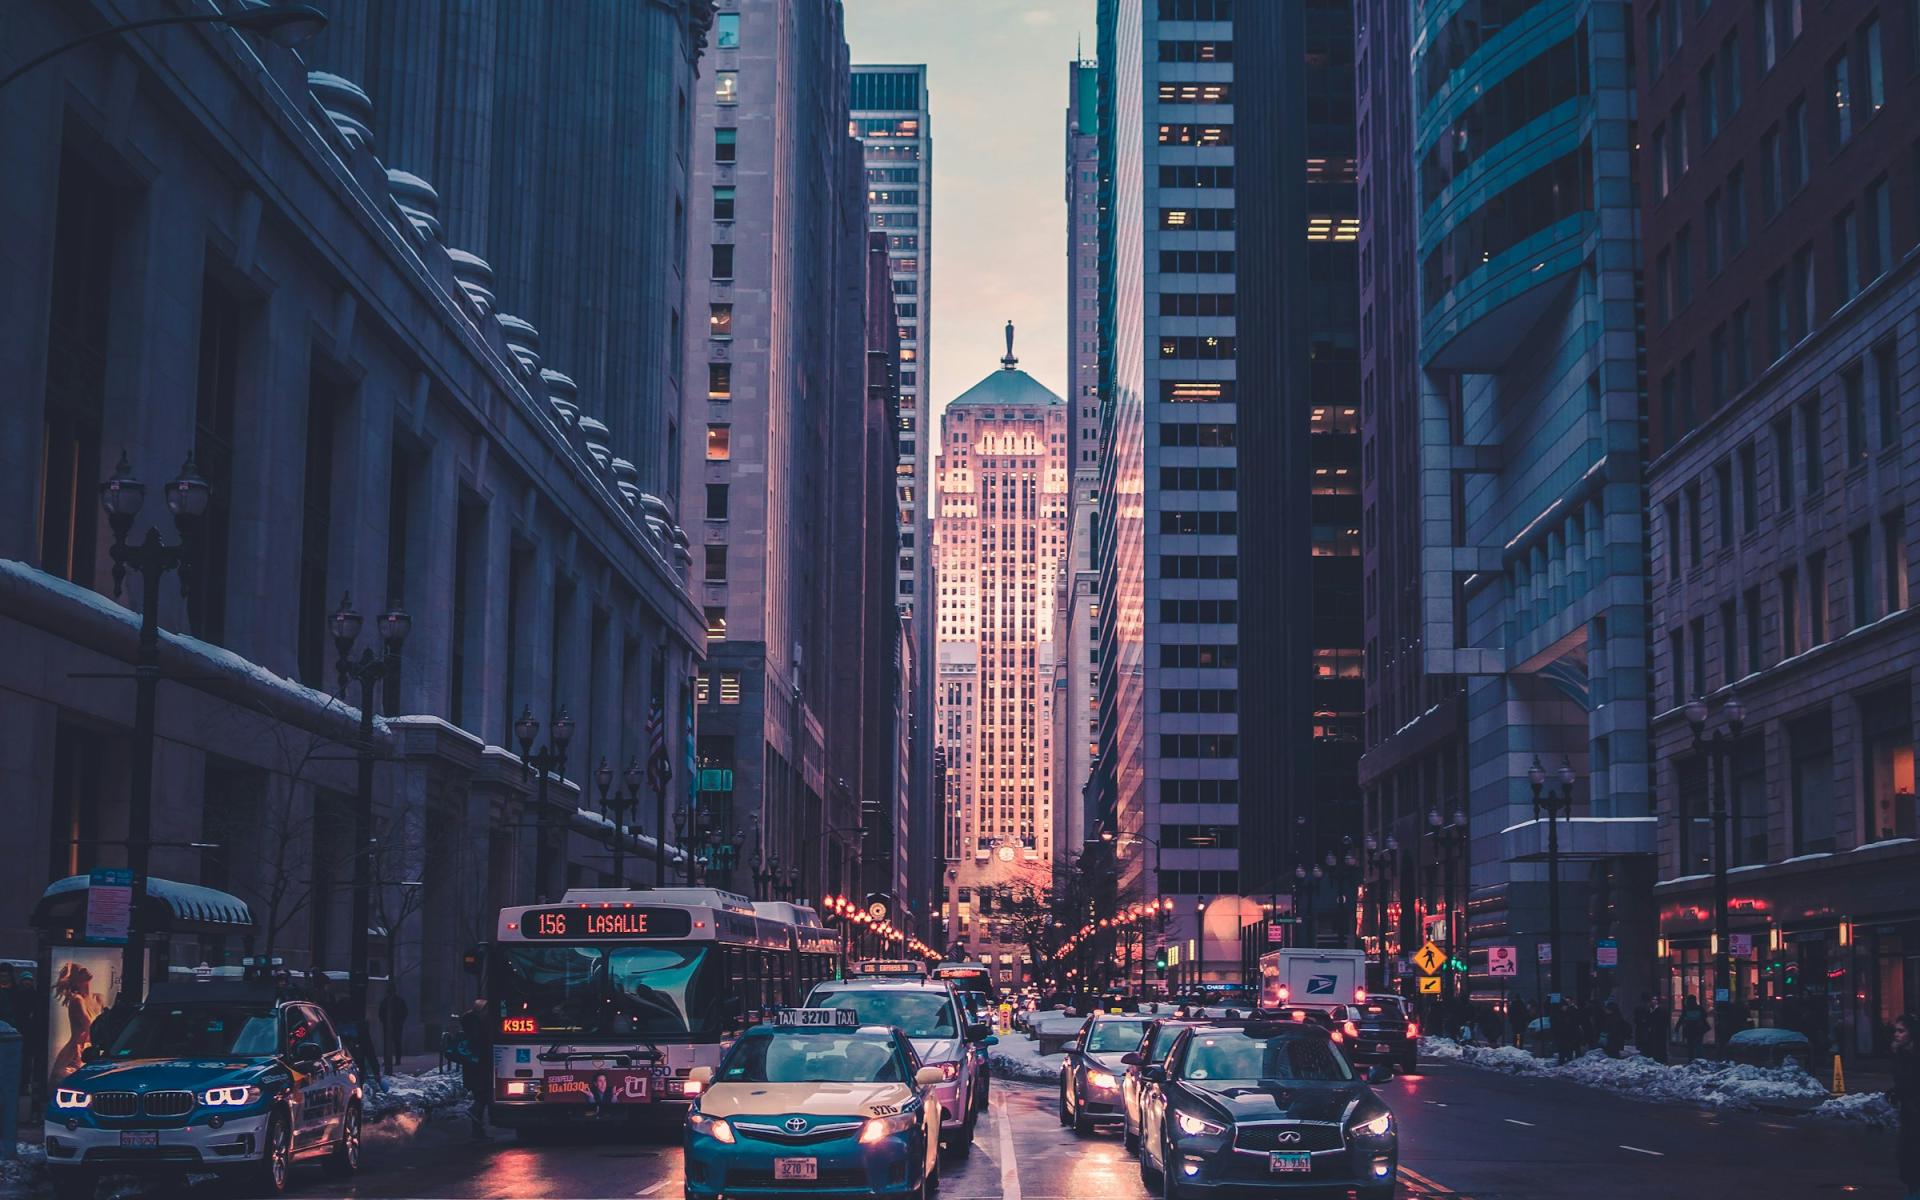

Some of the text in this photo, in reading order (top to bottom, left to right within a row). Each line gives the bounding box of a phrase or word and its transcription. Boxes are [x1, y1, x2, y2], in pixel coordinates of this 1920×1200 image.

[538, 914, 648, 934] 156 LASALLE
[779, 1011, 856, 1025] TAXI 3270 TAXI
[504, 1019, 535, 1032] K915
[782, 1163, 816, 1175] 3270 TX
